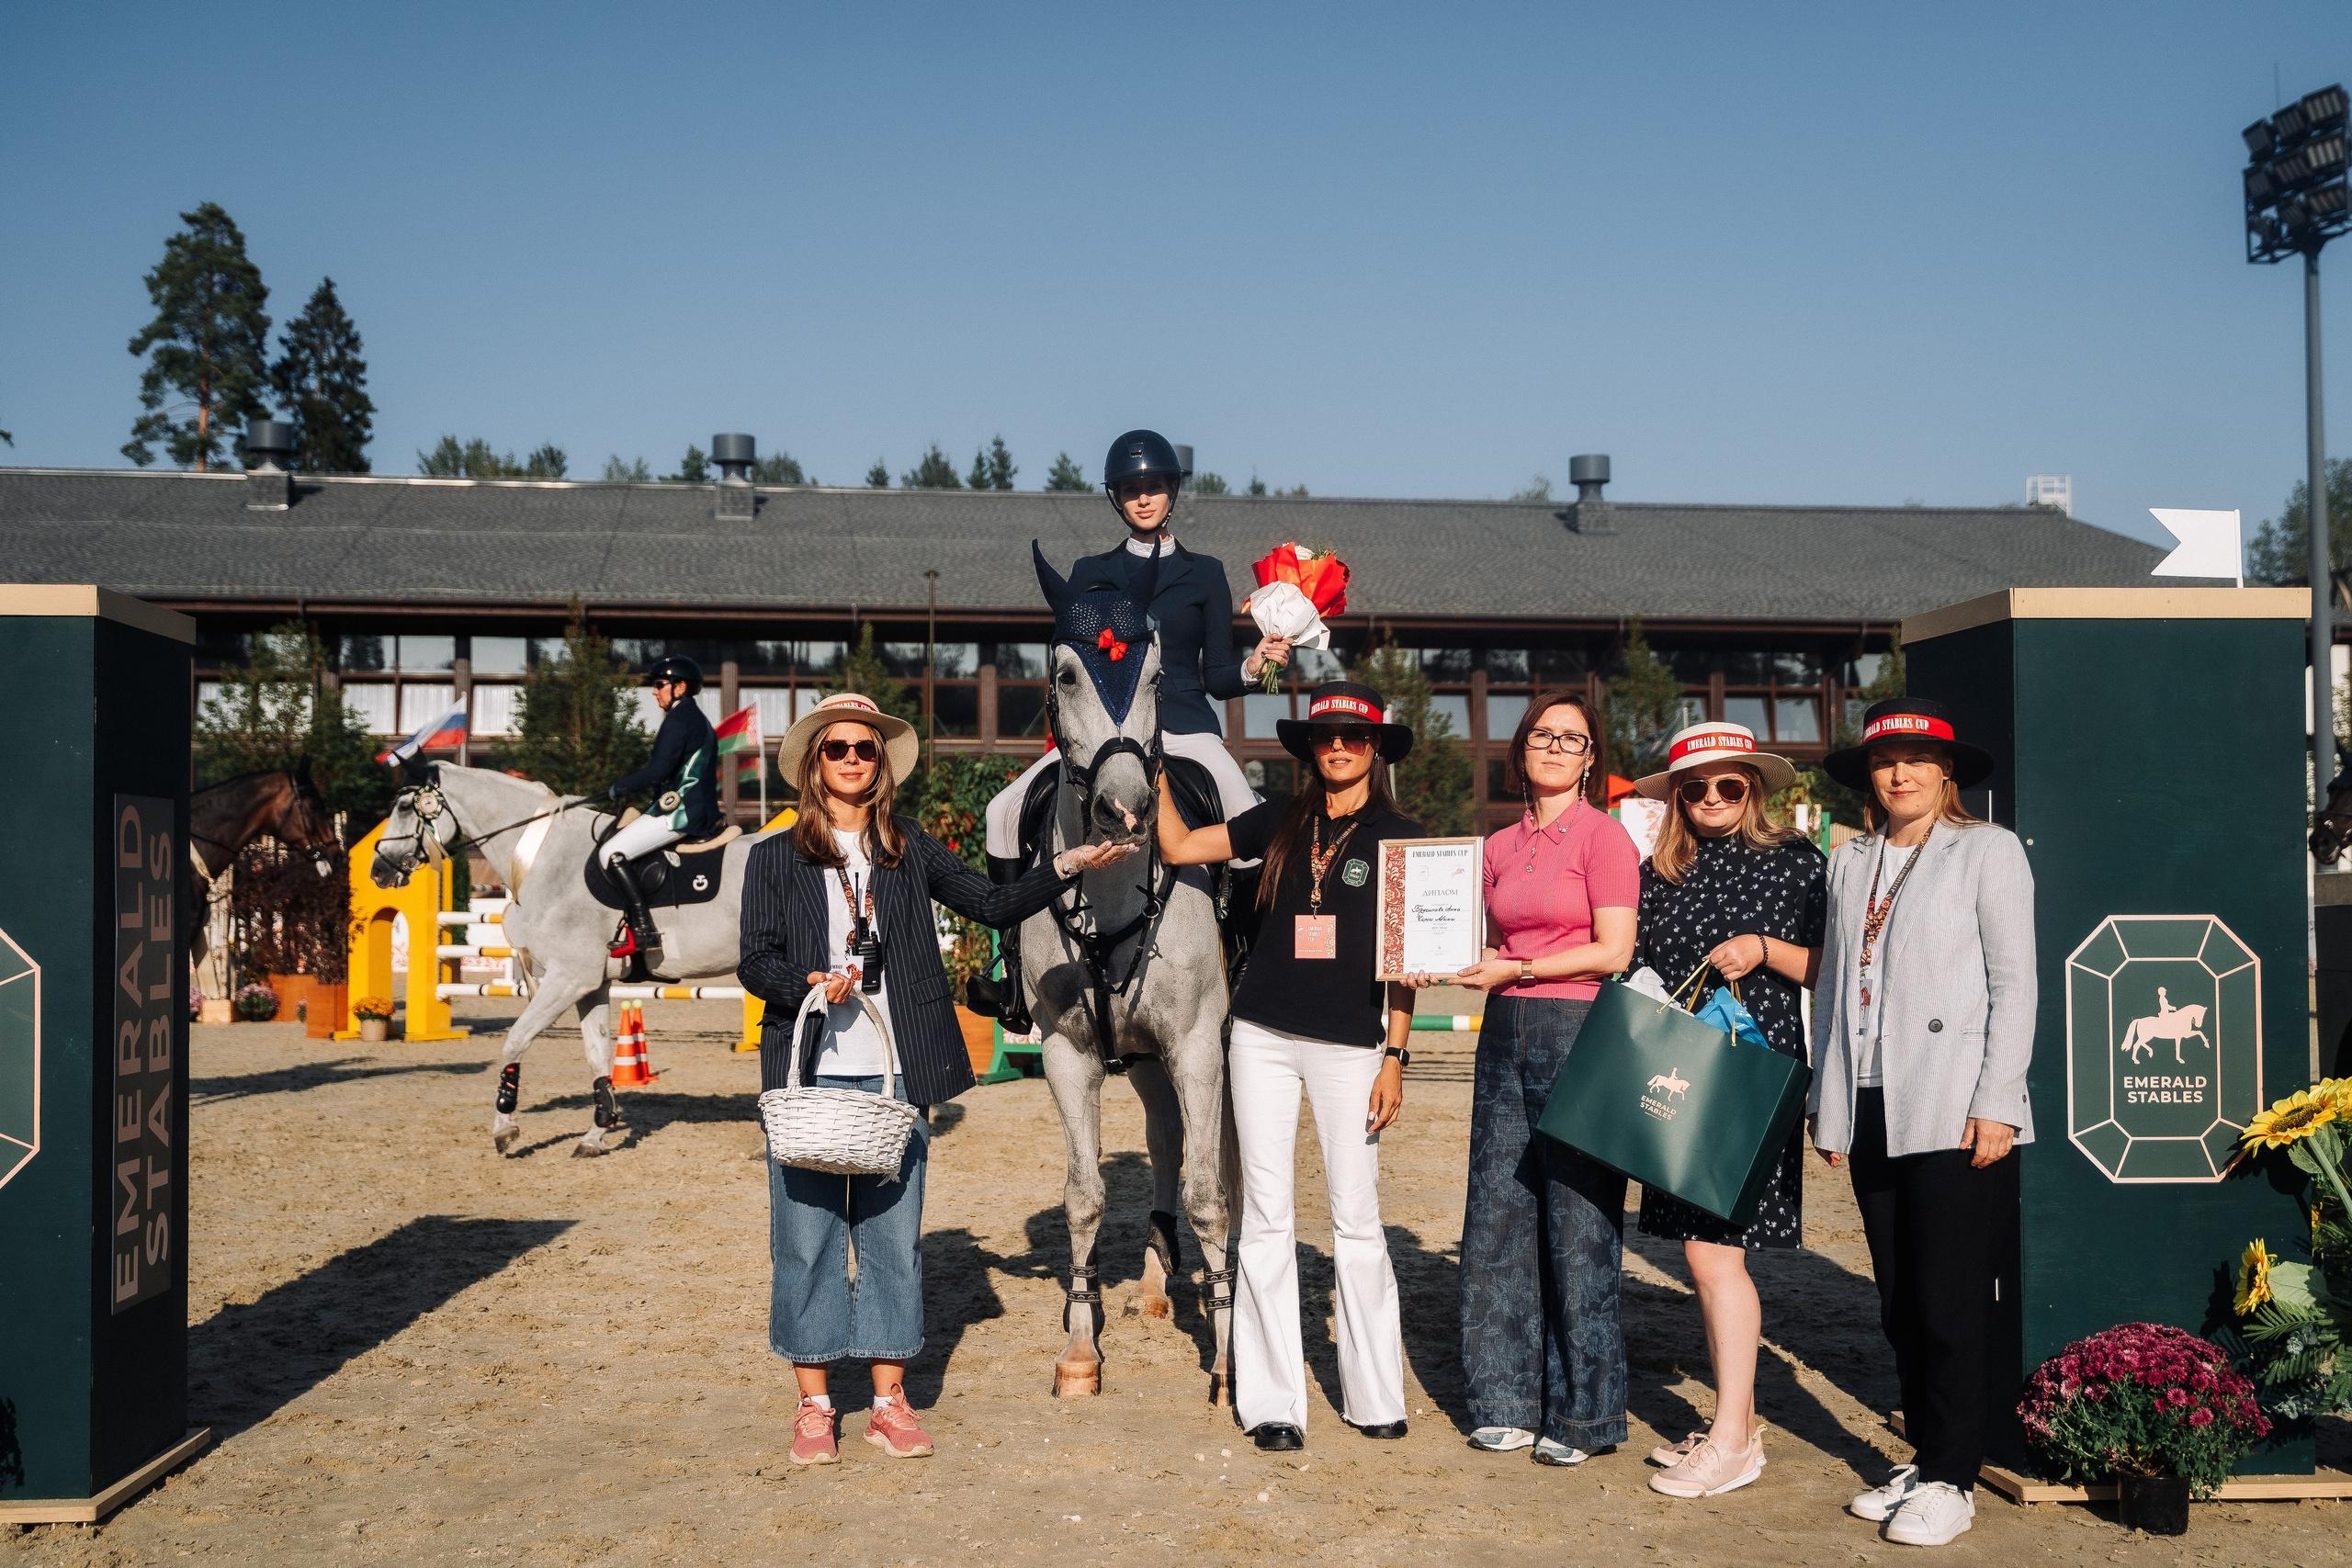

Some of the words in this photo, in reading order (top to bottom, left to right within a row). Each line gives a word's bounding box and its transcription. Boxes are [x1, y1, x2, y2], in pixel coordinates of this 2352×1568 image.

[1330, 698, 1357, 711] STABLES
[1358, 703, 1369, 715] CUP
[1882, 717, 1913, 731] STABLES
[1915, 717, 1929, 731] CUP
[1687, 736, 1716, 751] EMERALD
[1717, 736, 1744, 748] STABLES
[1744, 739, 1753, 750] CUP
[116, 805, 143, 1304] EMERALD
[145, 830, 172, 1267] STABLES
[2123, 1076, 2208, 1089] EMERALD
[1640, 1095, 1677, 1115] EMERALD
[2127, 1090, 2204, 1103] STABLES
[1639, 1101, 1672, 1121] STABLES
